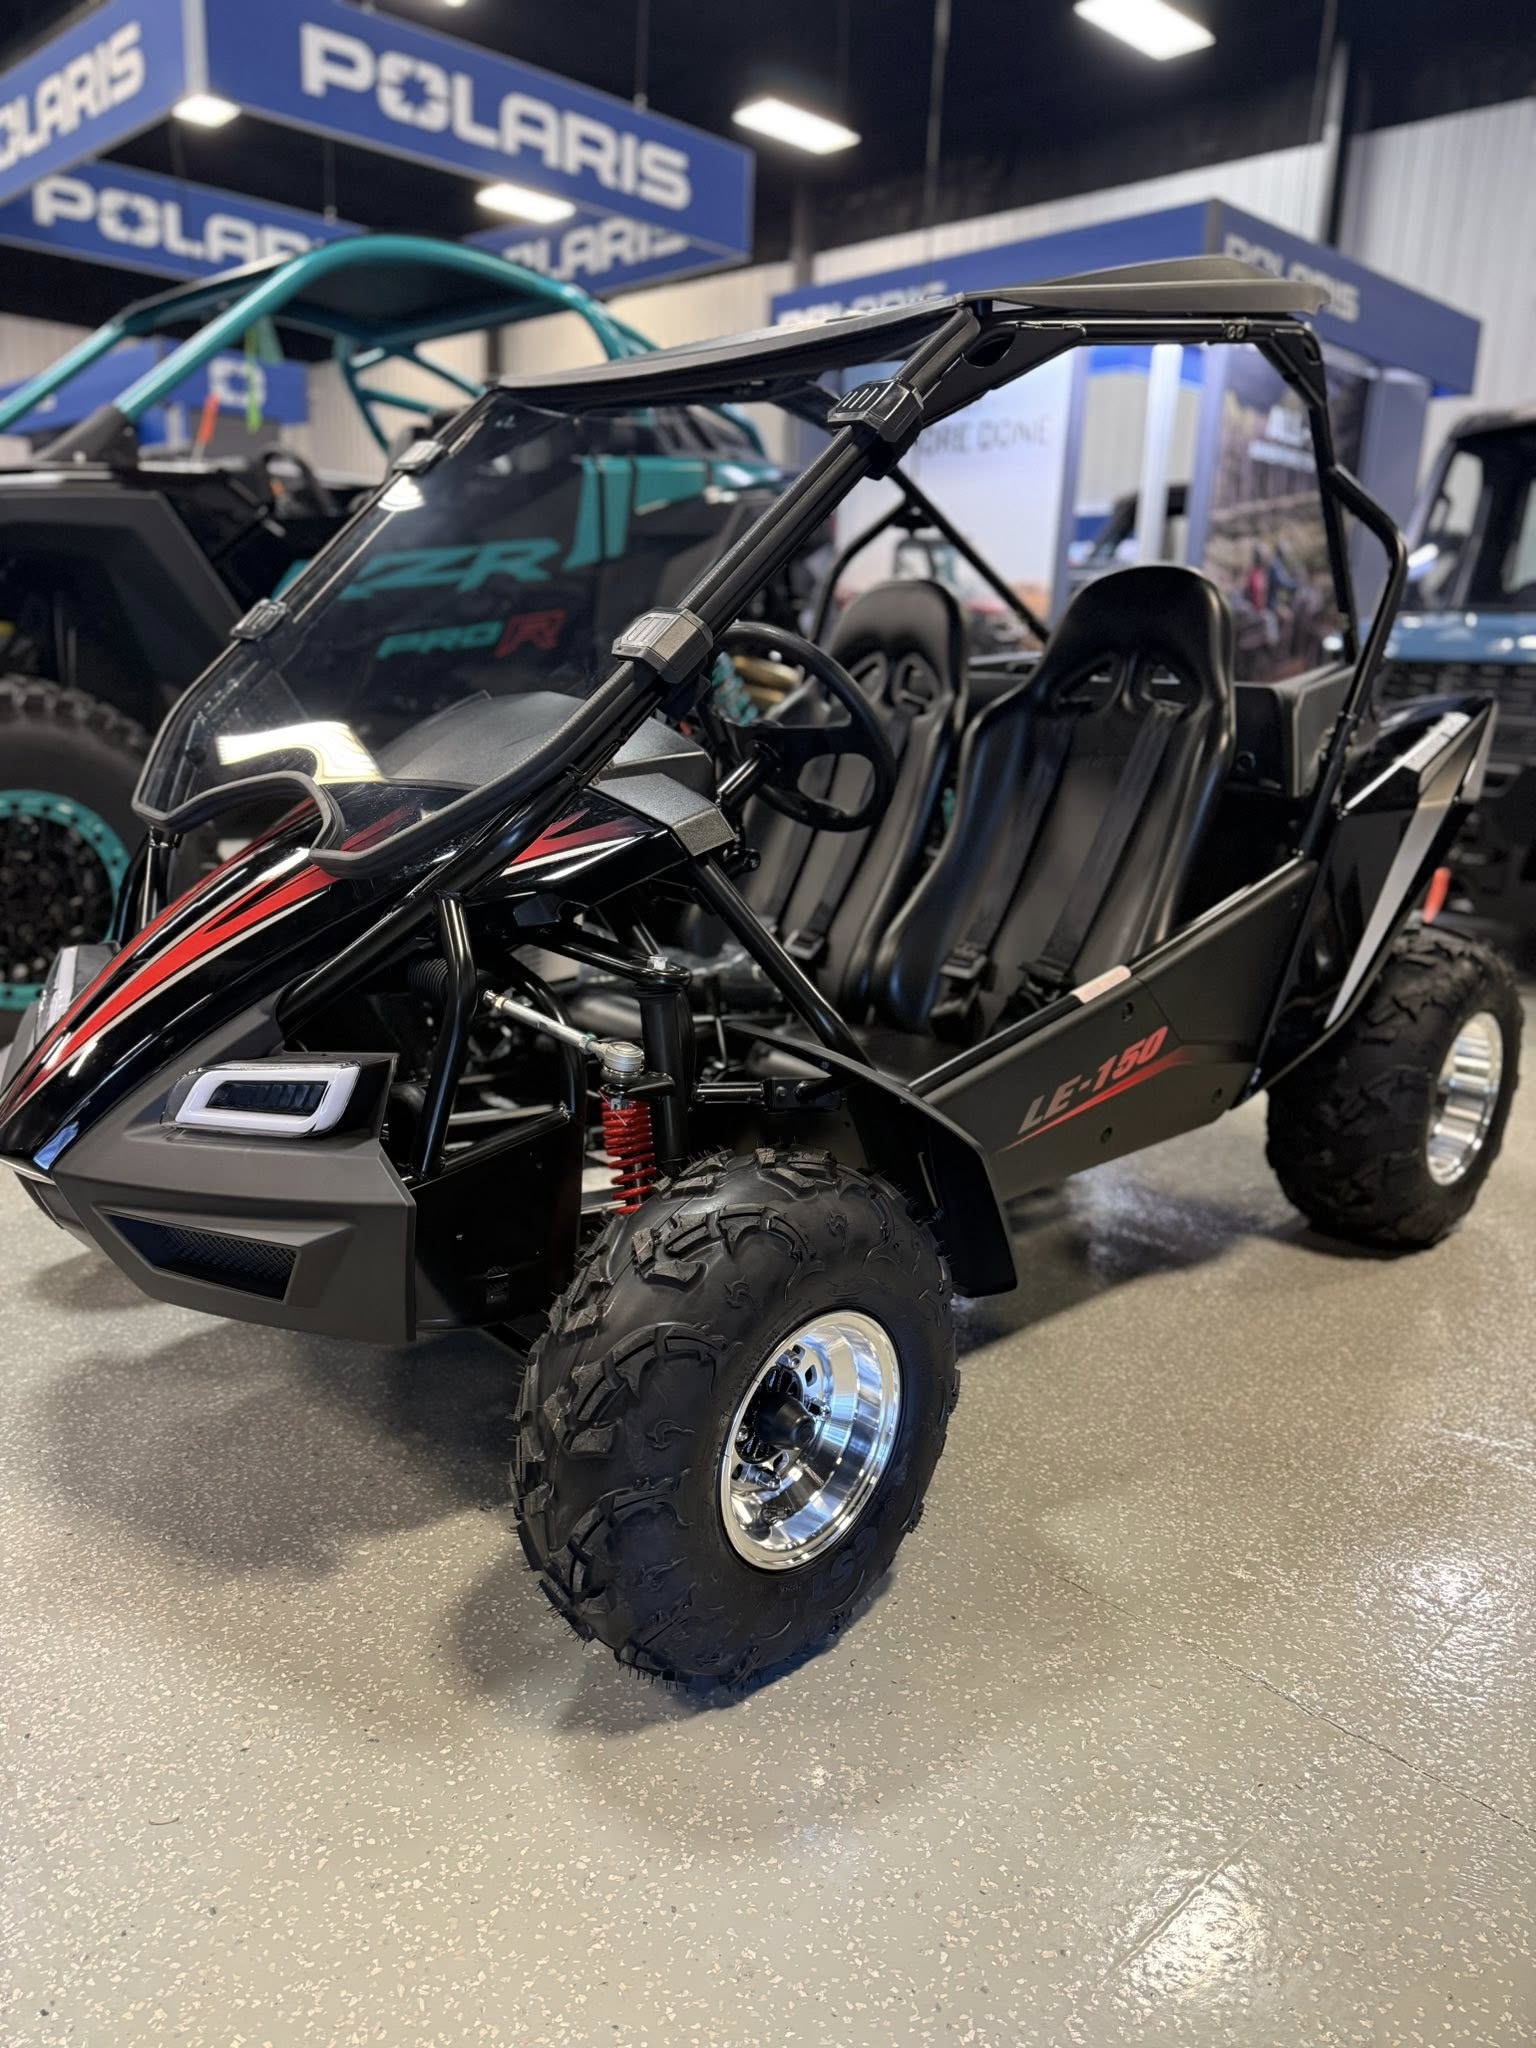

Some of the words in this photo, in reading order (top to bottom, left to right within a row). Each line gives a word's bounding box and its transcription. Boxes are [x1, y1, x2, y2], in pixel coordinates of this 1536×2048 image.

[301, 22, 692, 210] POLARIS
[32, 175, 326, 265] POLAR
[1018, 1026, 1168, 1134] LE-150
